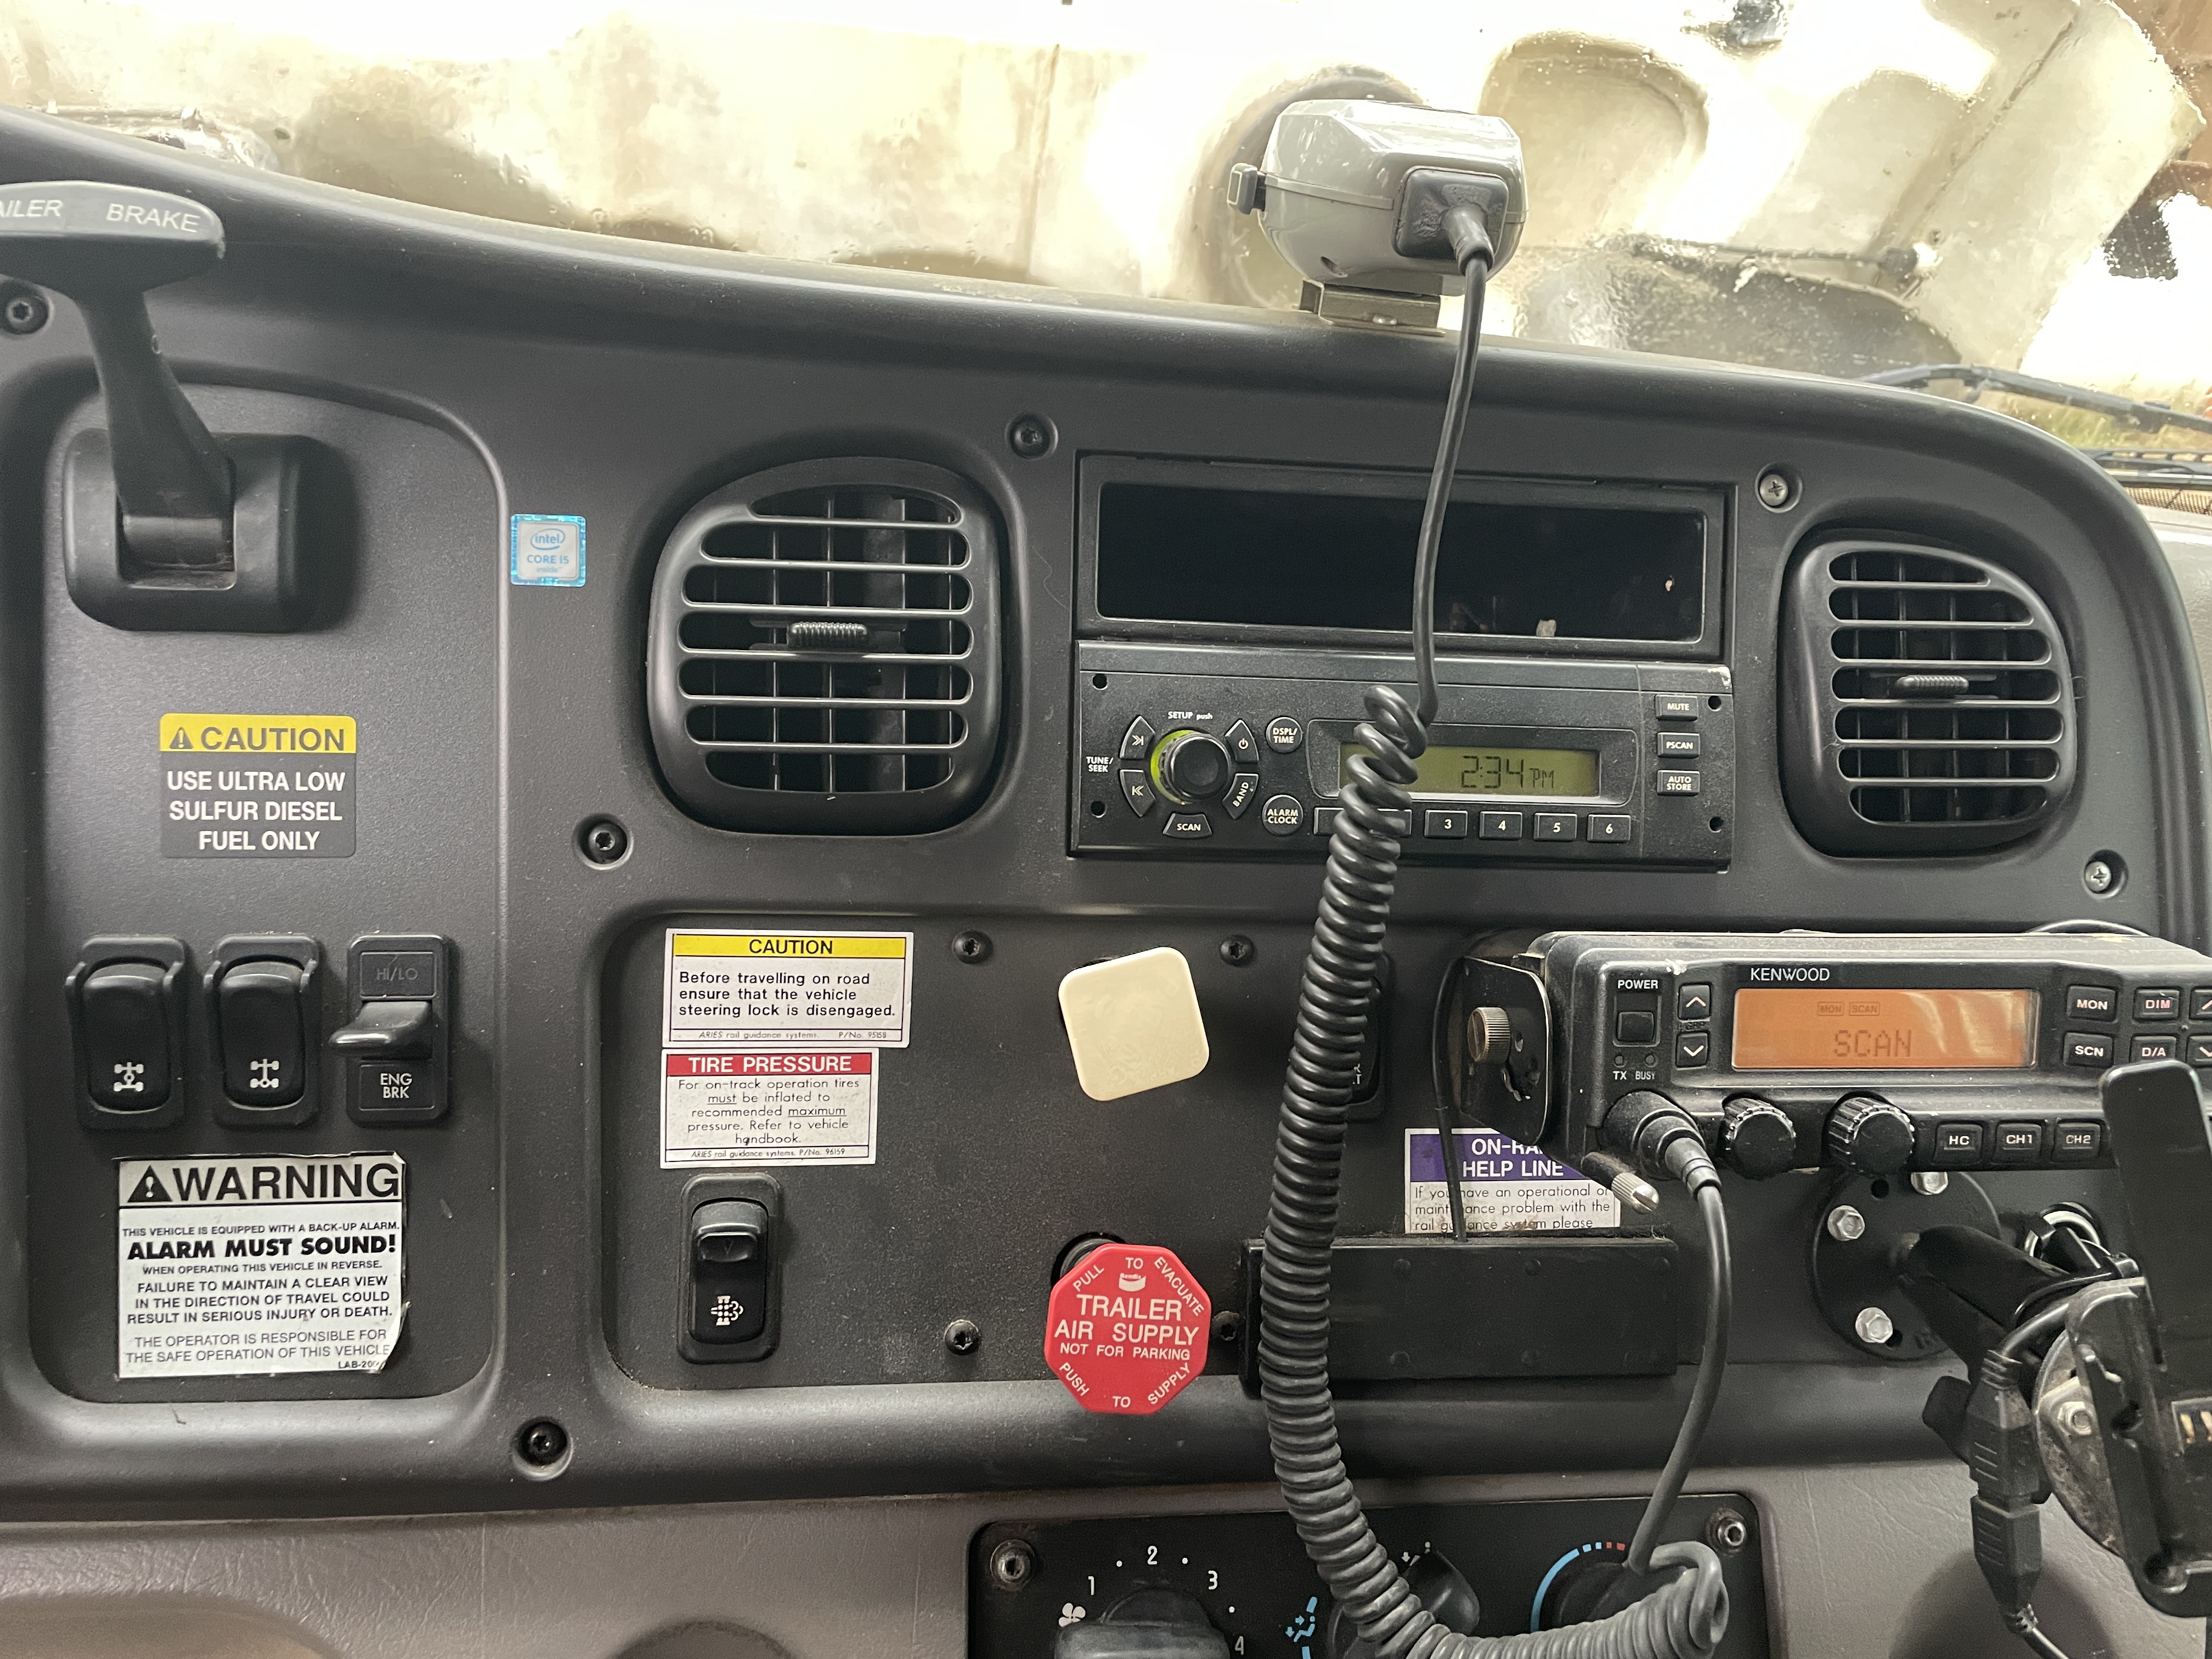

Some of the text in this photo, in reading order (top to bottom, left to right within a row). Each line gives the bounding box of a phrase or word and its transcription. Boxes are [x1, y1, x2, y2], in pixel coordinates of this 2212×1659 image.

[106, 204, 200, 233] BRAKE
[535, 534, 560, 543] intel
[527, 555, 556, 563] CORE
[1273, 727, 1297, 736] DSPL/
[201, 727, 343, 751] CAUTION
[1273, 735, 1294, 743] TIME
[1086, 757, 1113, 765] TUNE/
[1461, 755, 1554, 789] 2:34 PM
[167, 771, 345, 791] USE ULTRA LOW
[1233, 782, 1249, 806] BAND
[170, 800, 342, 821] SULFUR DIESEL
[1177, 823, 1201, 831] SCAN
[1444, 819, 1452, 829] 3
[1498, 820, 1506, 831] 4
[1553, 822, 1560, 832] 5
[1605, 823, 1613, 833] 6
[199, 831, 320, 850] FUEL ONLY
[749, 939, 833, 954] CAUTION
[376, 968, 418, 981] HI/LO
[680, 972, 870, 986] Before travelling on road
[1751, 968, 1830, 981] KENWOOD
[1618, 980, 1658, 989] POWER
[679, 989, 856, 1001] ensure that the vehicle
[679, 1005, 895, 1018] steering lock is disengaged.
[2076, 999, 2170, 1010] MON DIM
[1835, 1030, 1911, 1057] SCAN
[2075, 1046, 2166, 1057] SCN D/A
[689, 1056, 852, 1073] TIRE PRESSURE
[380, 1074, 412, 1086] ENG
[1612, 1071, 1655, 1080] TX BUSY
[678, 1078, 859, 1090] For on-track operation tires
[383, 1087, 409, 1098] BRK
[708, 1092, 830, 1104] must be inflated to
[691, 1106, 845, 1117] recommended maximum
[687, 1120, 849, 1133] pressure. Refer to vehicle
[735, 1132, 802, 1146] handbook.
[1949, 1135, 2091, 1146] HC CH1 CH2
[1463, 1161, 1564, 1177] HELP LINE
[173, 1163, 399, 1201] WARNING
[1415, 1186, 1590, 1200] If an operational
[1502, 1200, 1610, 1215] problem with the
[212, 1226, 265, 1234] EQUIPPED
[269, 1224, 295, 1233] WITH
[298, 1224, 305, 1232] A
[309, 1223, 357, 1232] BACK-UP
[360, 1222, 400, 1230] ALARM.
[1415, 1218, 1593, 1231] rail please
[127, 1235, 396, 1260] ALARM MUST SOUND!
[143, 1261, 382, 1274] WHEN OPERATING THIS VEHICLE IN REVERSE.
[138, 1276, 388, 1293] FAILURE TO MAINTAIN A CLEAR VIEW
[1073, 1256, 1204, 1316] PULL TO EVACUATE
[136, 1291, 390, 1308] IN THE DIRECTION OF TRAVEL COULD
[1076, 1294, 1182, 1321] TRAILER
[127, 1306, 392, 1324] RESULT IN SERIOUS INJURY OR DEATH.
[136, 1329, 386, 1347] THE OPERATOR IS RESPONSIBLE FOR
[1054, 1319, 1199, 1345] AIR SUPPLY
[127, 1345, 390, 1363] THE SAFE OPERATION OF THIS VEHICLE
[1060, 1343, 1190, 1361] NOT FOR PARKING
[1059, 1362, 1190, 1408] PUSH TO SUPPLY
[1147, 1545, 1158, 1565] 2
[1088, 1576, 1094, 1595] 1
[1208, 1571, 1218, 1590] 3
[1234, 1635, 1244, 1655] 4
